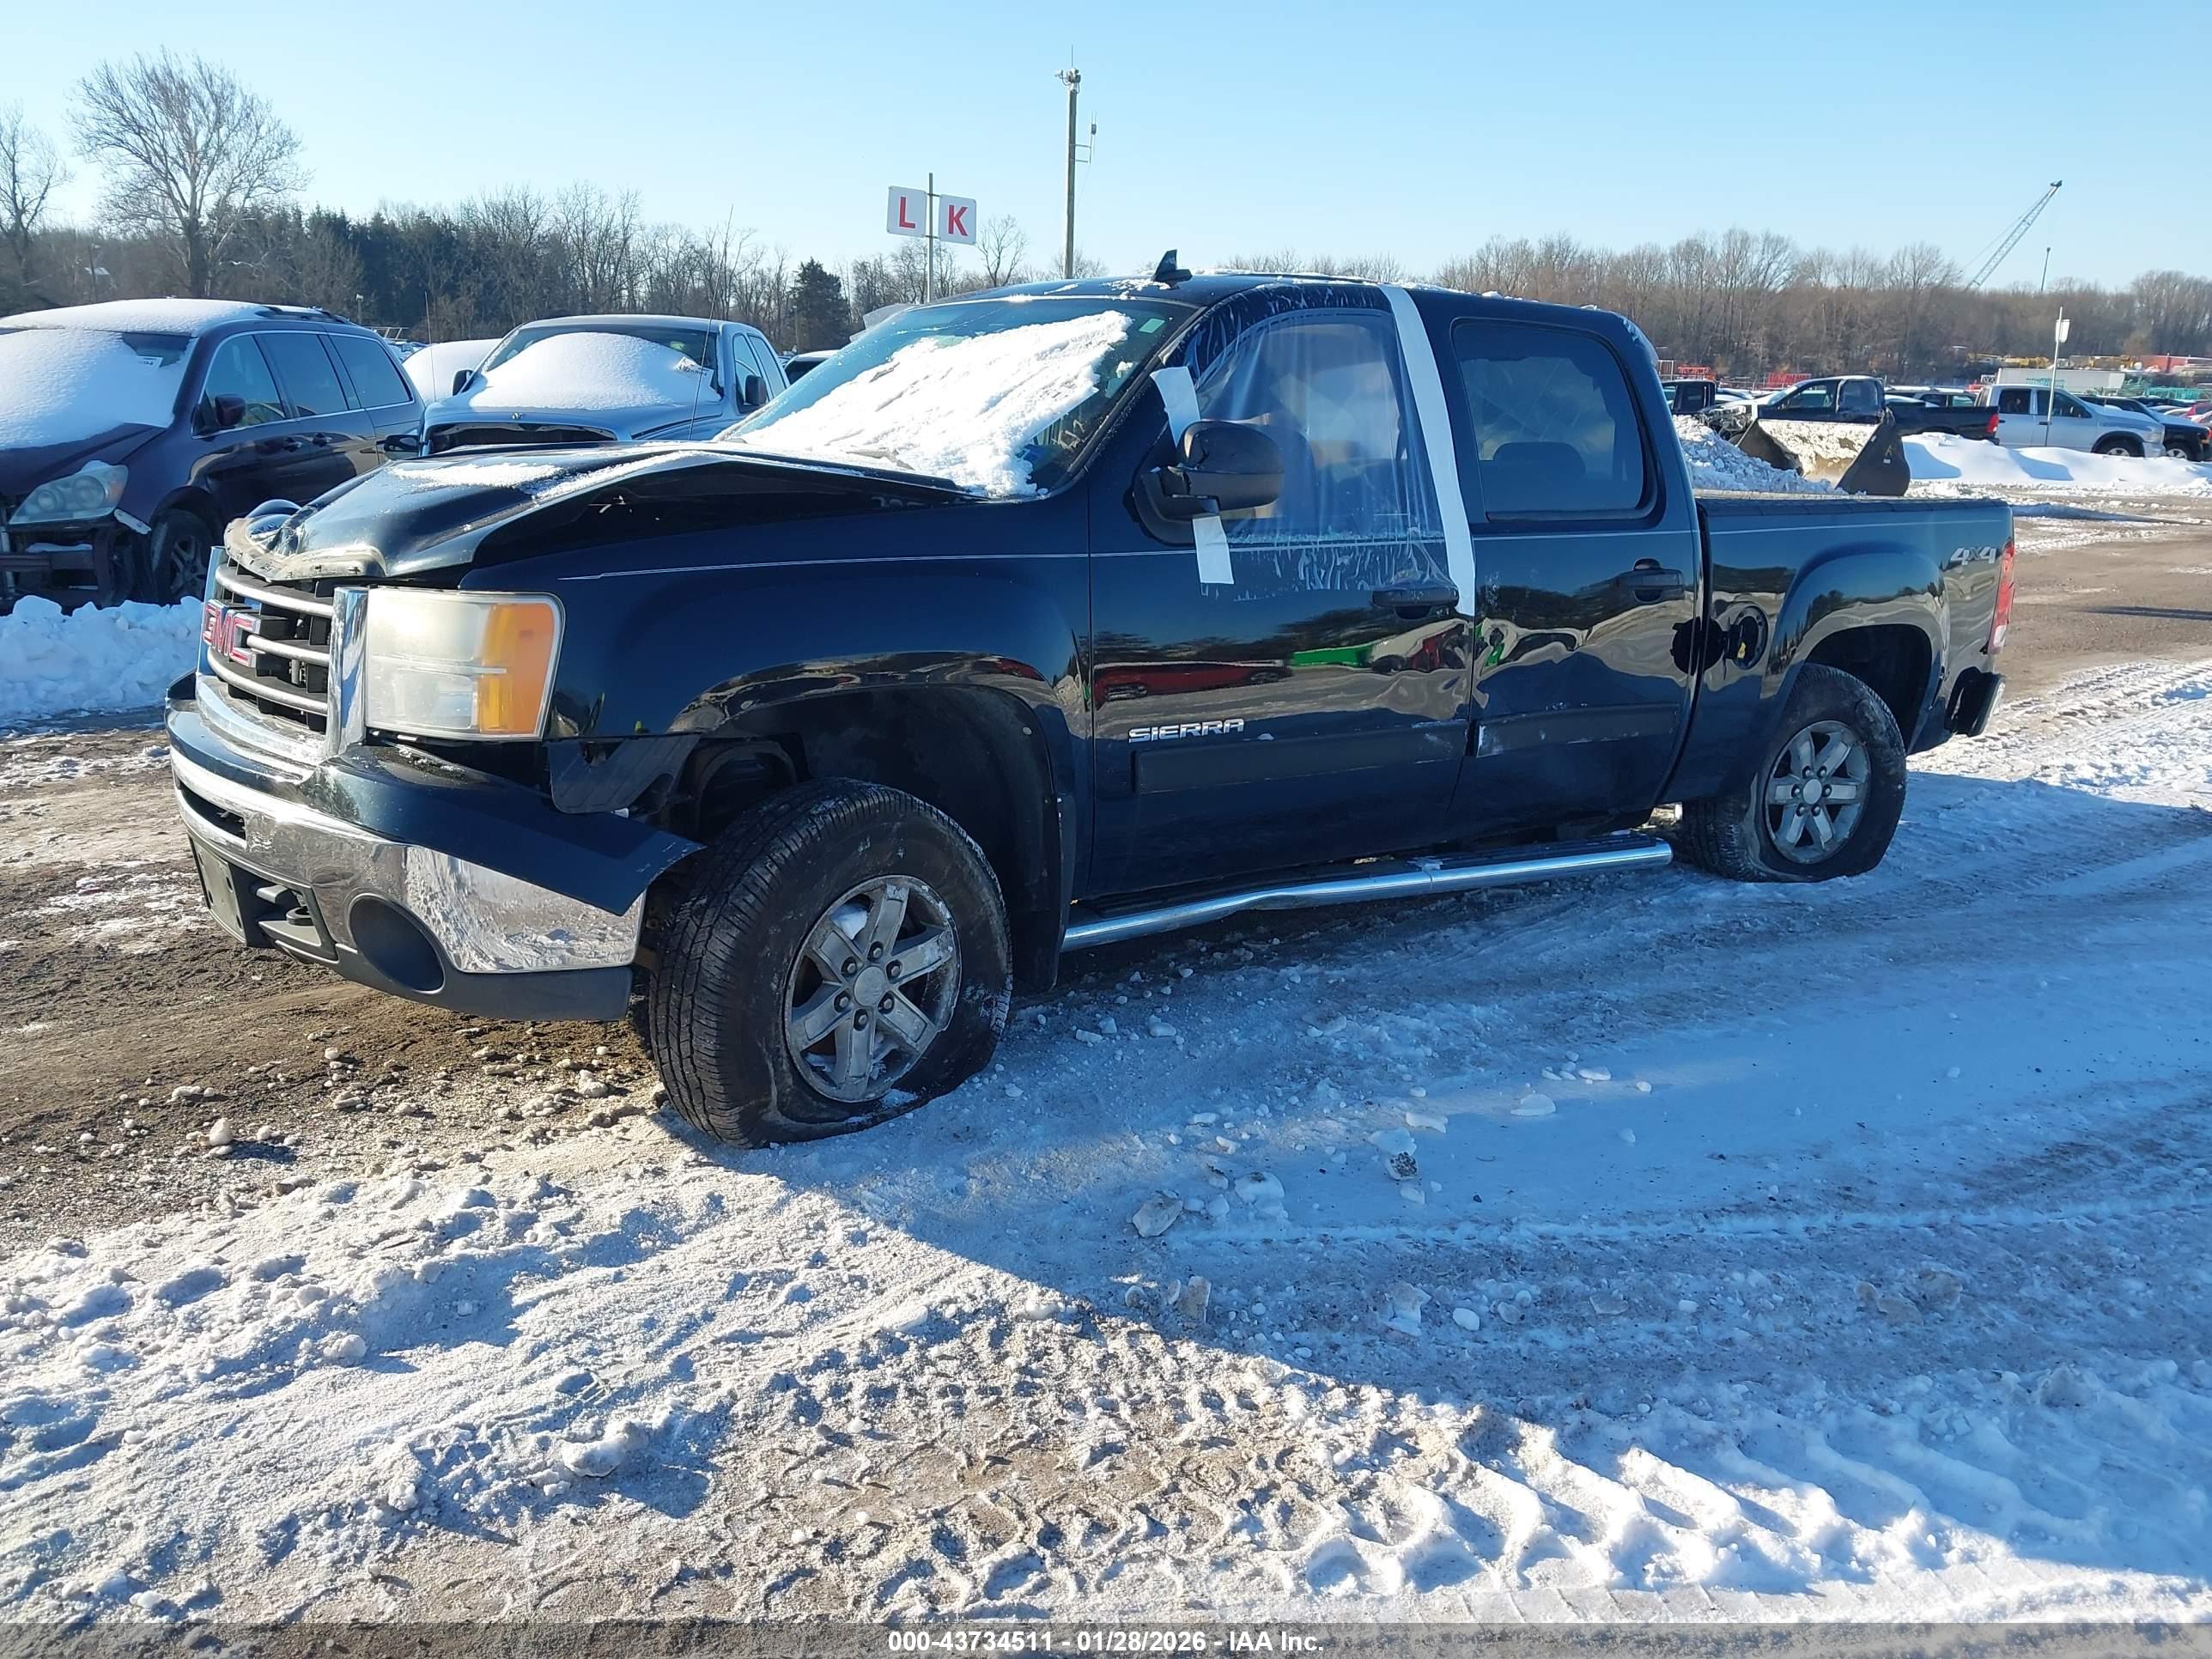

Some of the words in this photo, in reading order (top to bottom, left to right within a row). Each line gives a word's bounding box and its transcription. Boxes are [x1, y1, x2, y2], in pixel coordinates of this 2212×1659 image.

[898, 196, 916, 229] L
[948, 204, 969, 237] K
[203, 599, 261, 668] GMC
[1128, 718, 1245, 744] SIERRA
